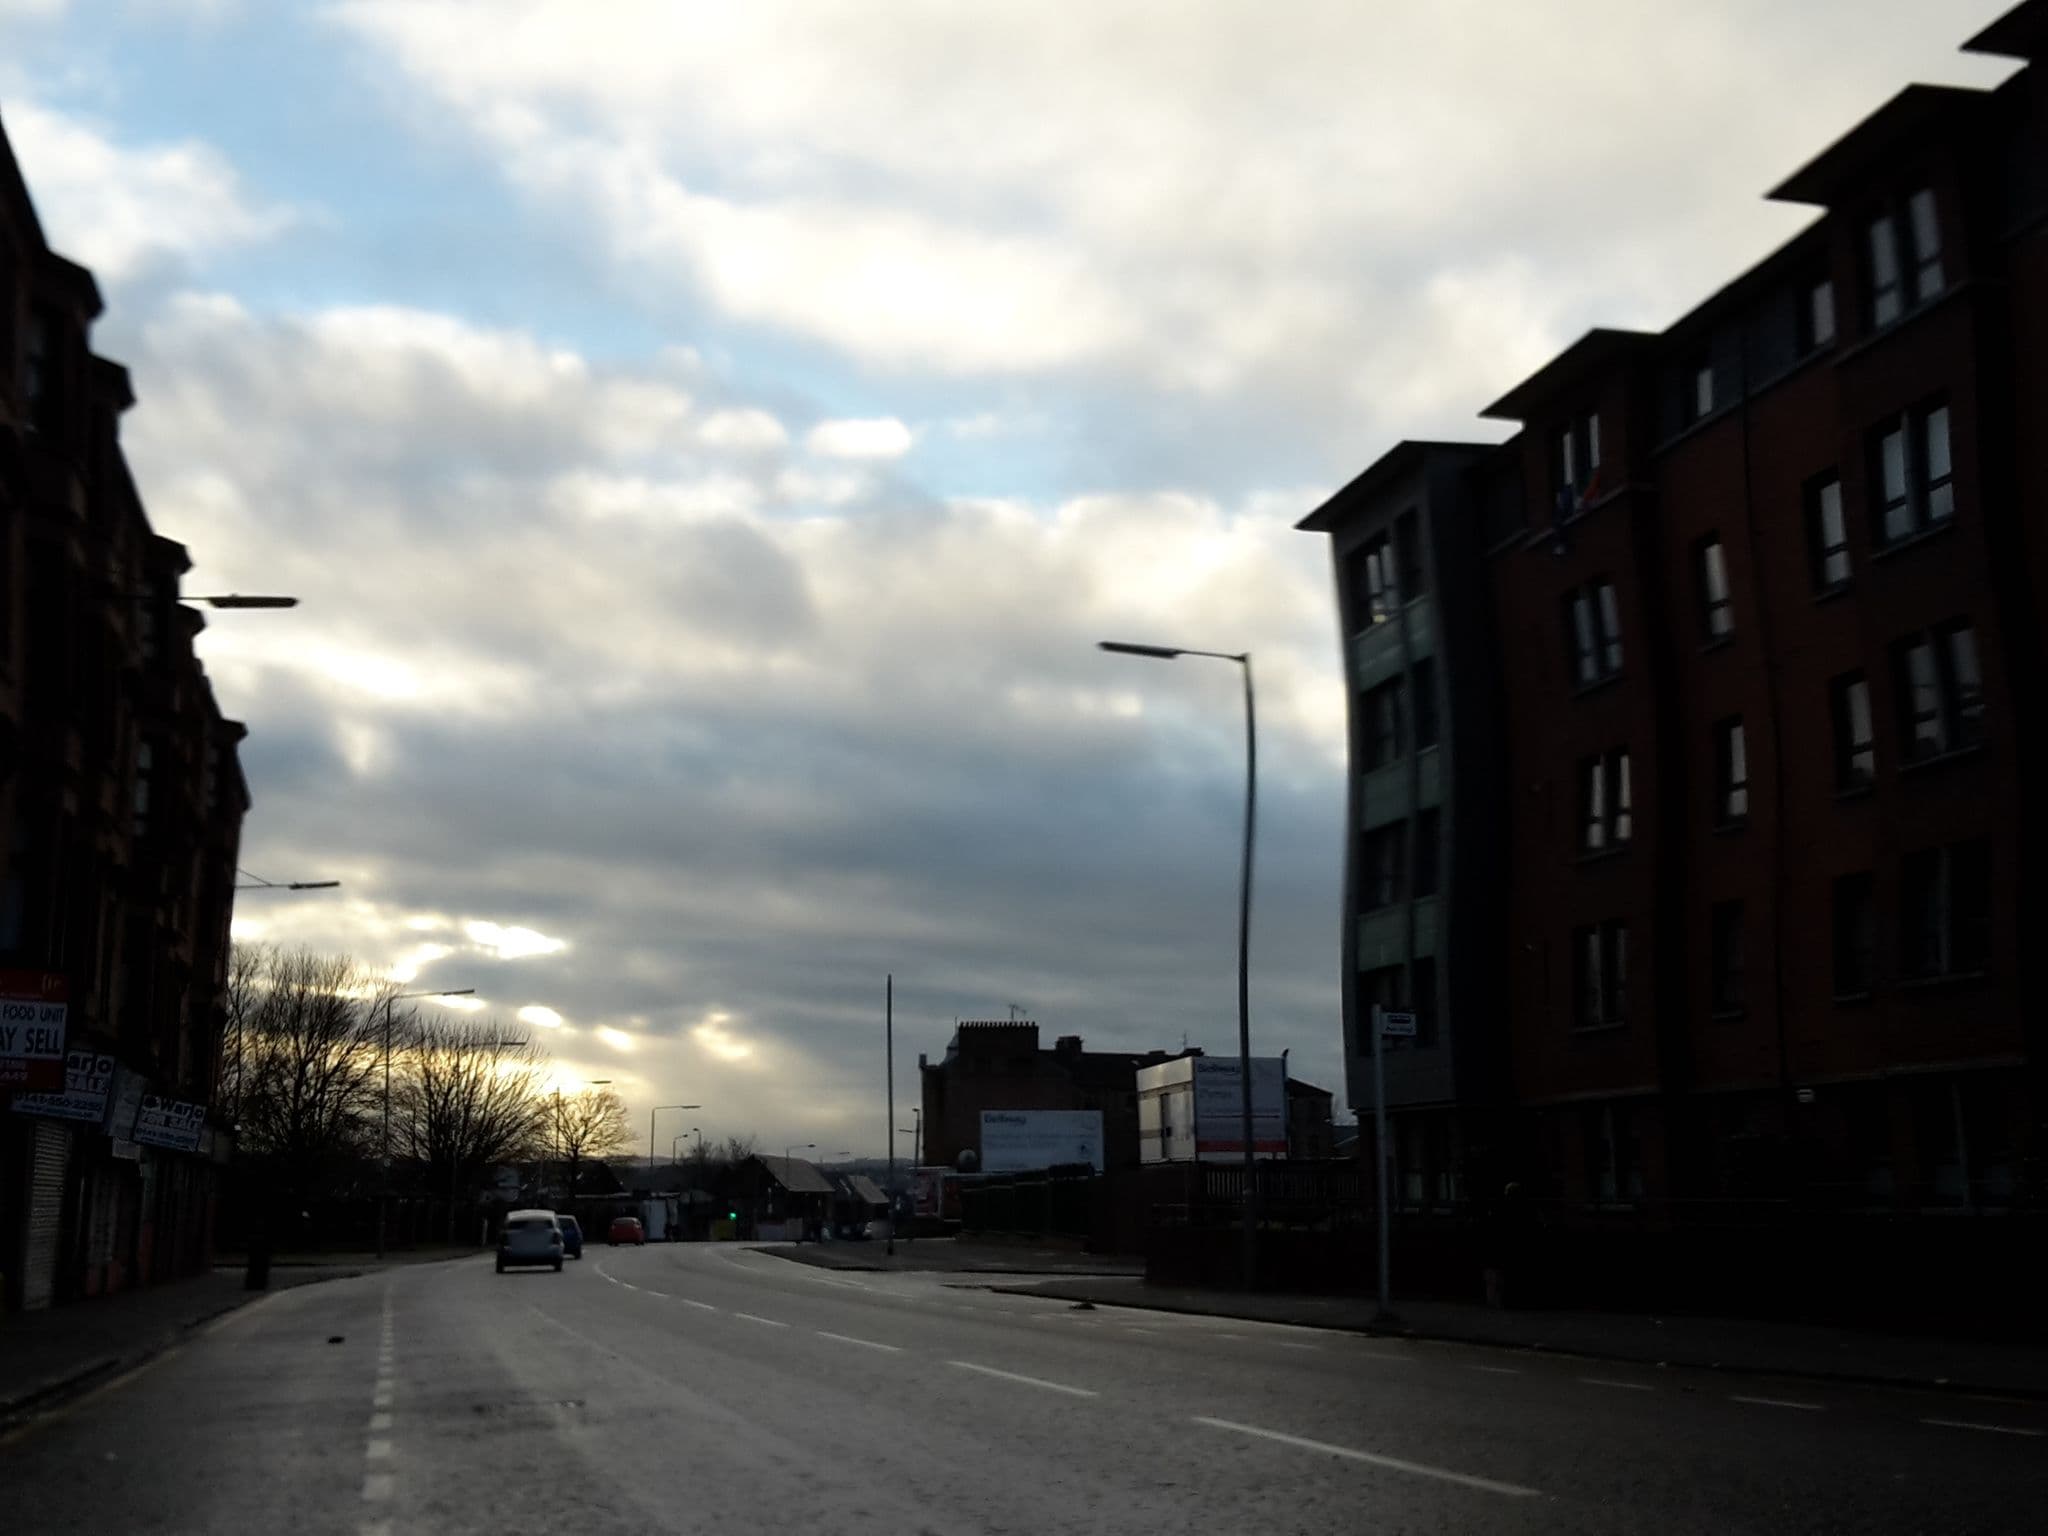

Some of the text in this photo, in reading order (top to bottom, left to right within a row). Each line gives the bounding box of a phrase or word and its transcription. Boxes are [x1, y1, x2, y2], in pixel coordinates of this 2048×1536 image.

[2, 1003, 65, 1022] FOOD UNIT
[24, 1028, 60, 1054] SELL
